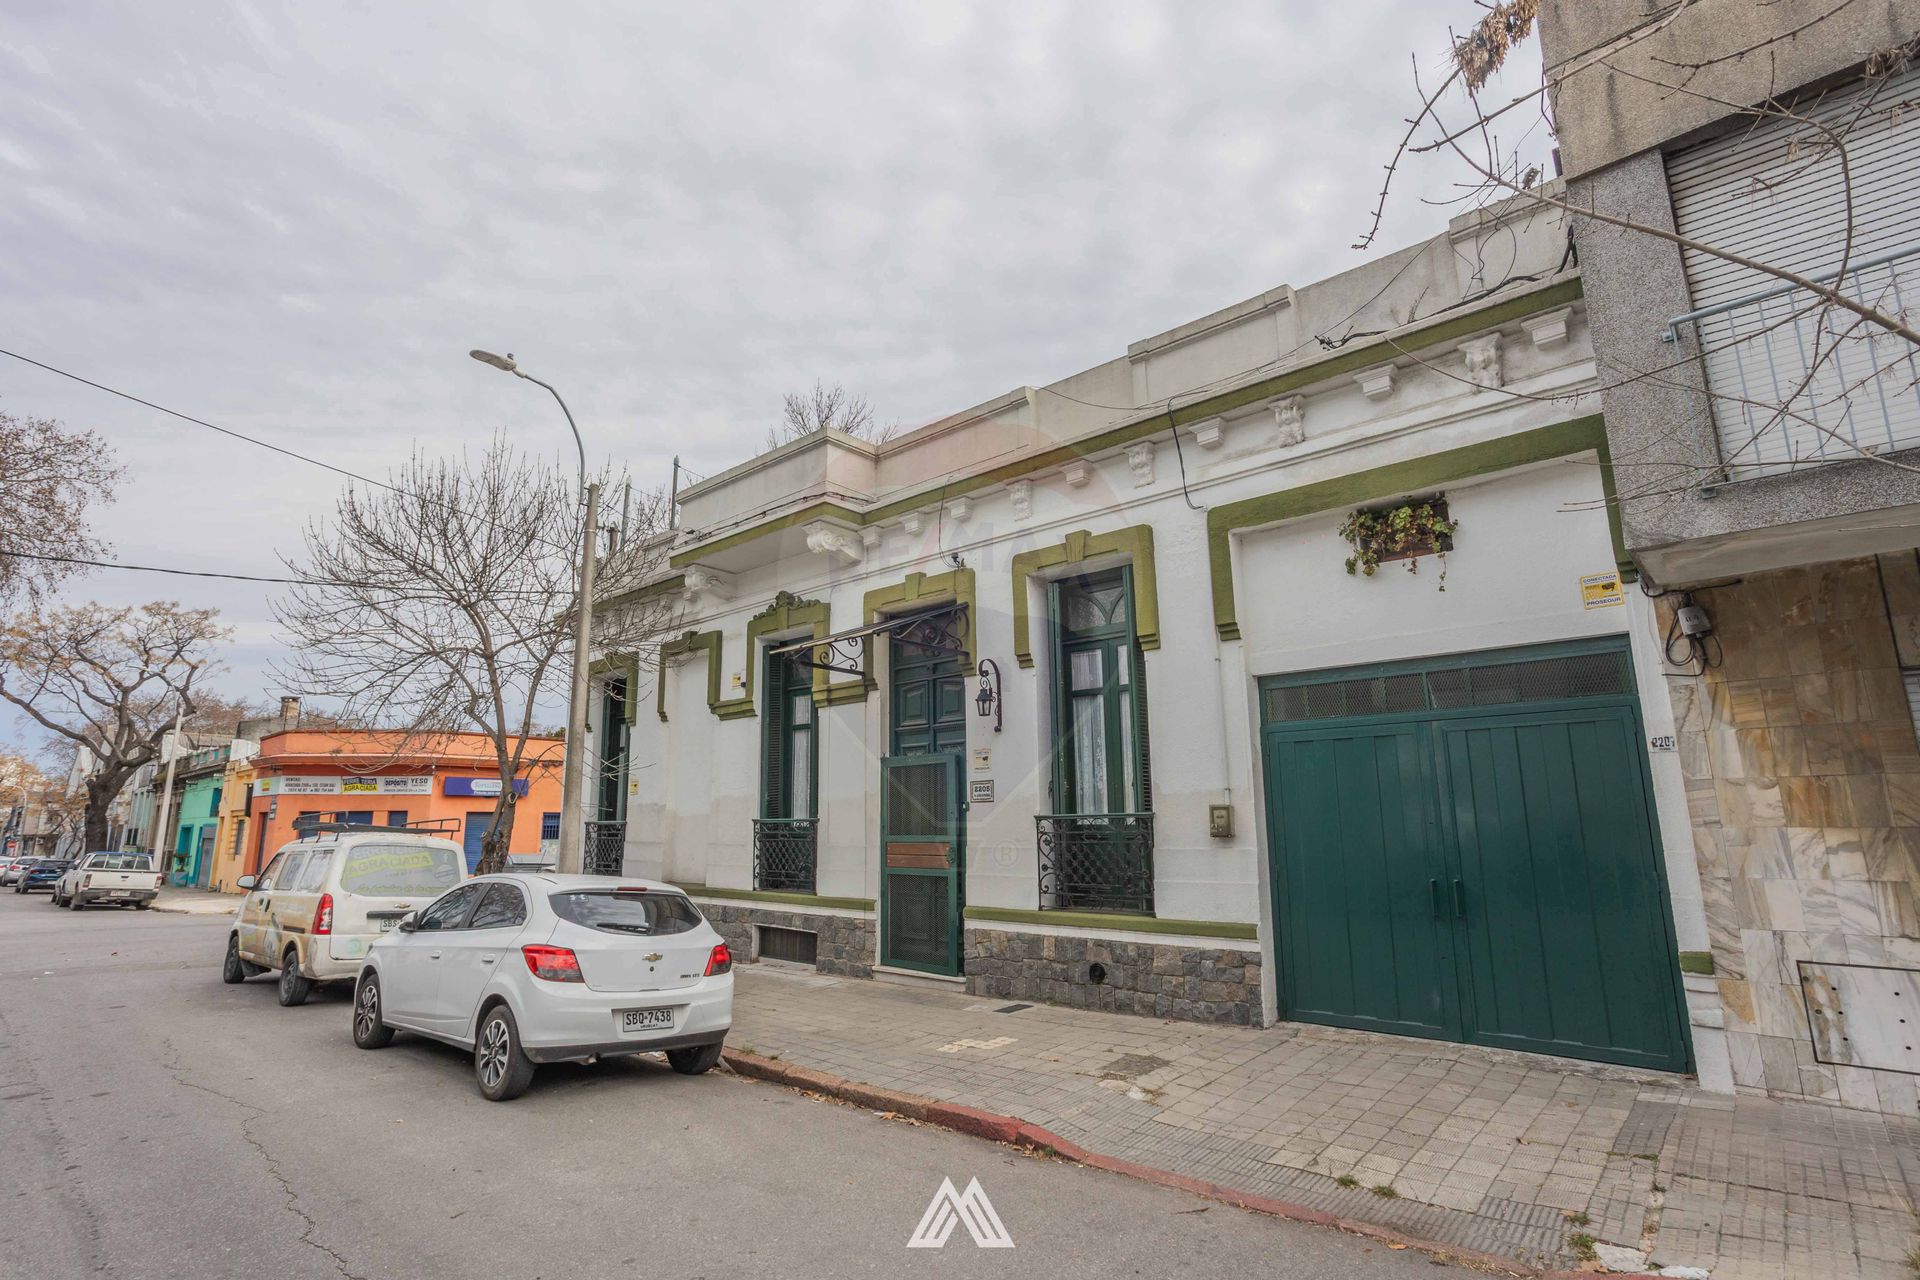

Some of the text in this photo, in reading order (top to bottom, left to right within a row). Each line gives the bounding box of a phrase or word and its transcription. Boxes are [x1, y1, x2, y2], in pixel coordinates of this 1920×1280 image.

[1586, 597, 1621, 606] PROSEGUR
[411, 777, 428, 785] YESO
[974, 785, 990, 793] 2205
